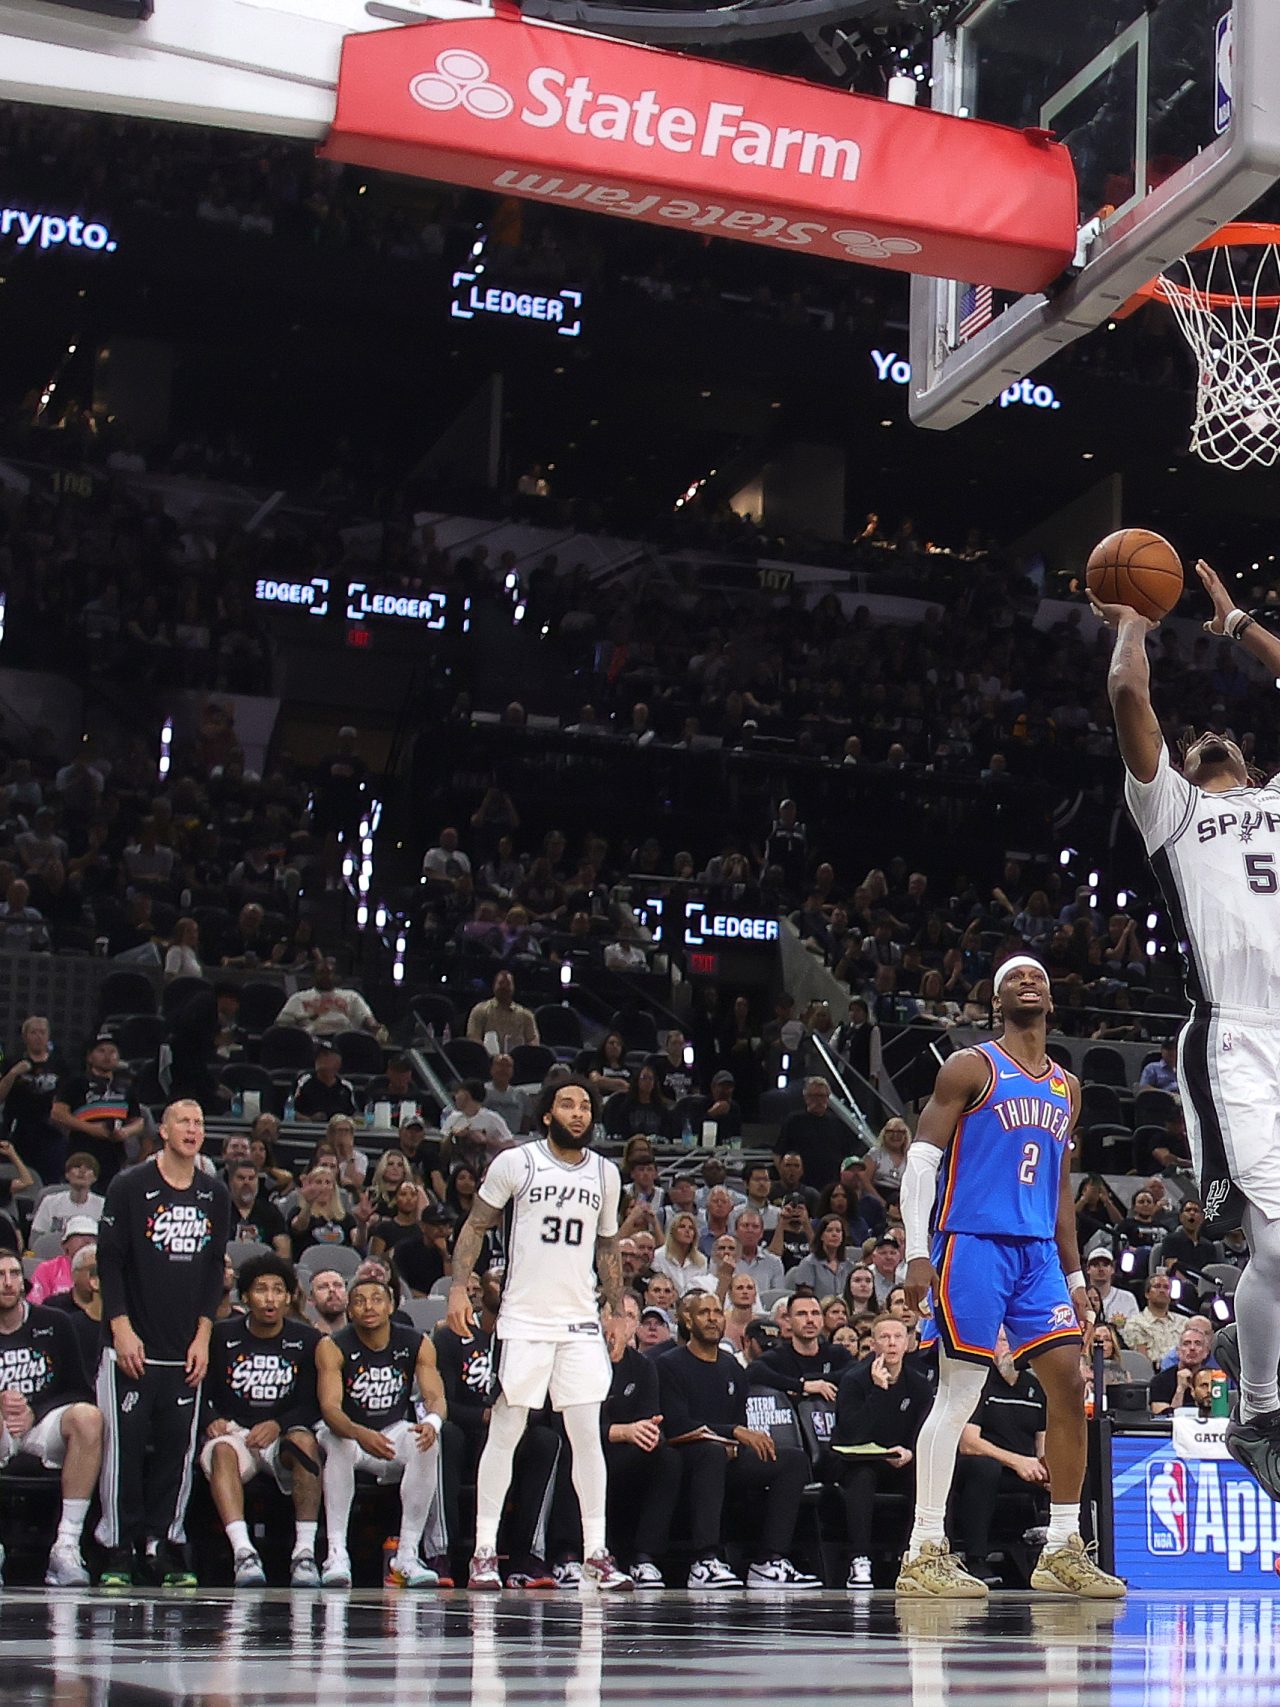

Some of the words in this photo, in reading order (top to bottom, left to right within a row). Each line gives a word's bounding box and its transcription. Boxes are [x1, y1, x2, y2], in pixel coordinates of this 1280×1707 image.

[0, 208, 118, 252] rypto.
[470, 286, 564, 322] LEDGER
[871, 349, 912, 385] Yo
[990, 378, 1061, 409] pto.
[256, 579, 315, 605] EDGER
[361, 593, 432, 620] LEDGER
[1244, 853, 1280, 894] 5
[700, 914, 779, 940] LEDGER
[994, 1098, 1069, 1141] THUNDER
[1019, 1143, 1039, 1183] 2
[172, 1206, 198, 1221] GO
[529, 1186, 601, 1211] SPURS
[152, 1211, 208, 1246] Spurs
[541, 1216, 583, 1246] 30
[231, 1360, 293, 1392] Spurs
[253, 1355, 280, 1369] GO
[370, 1367, 393, 1381] GO
[351, 1371, 403, 1403] Spurs
[1211, 1385, 1222, 1398] G
